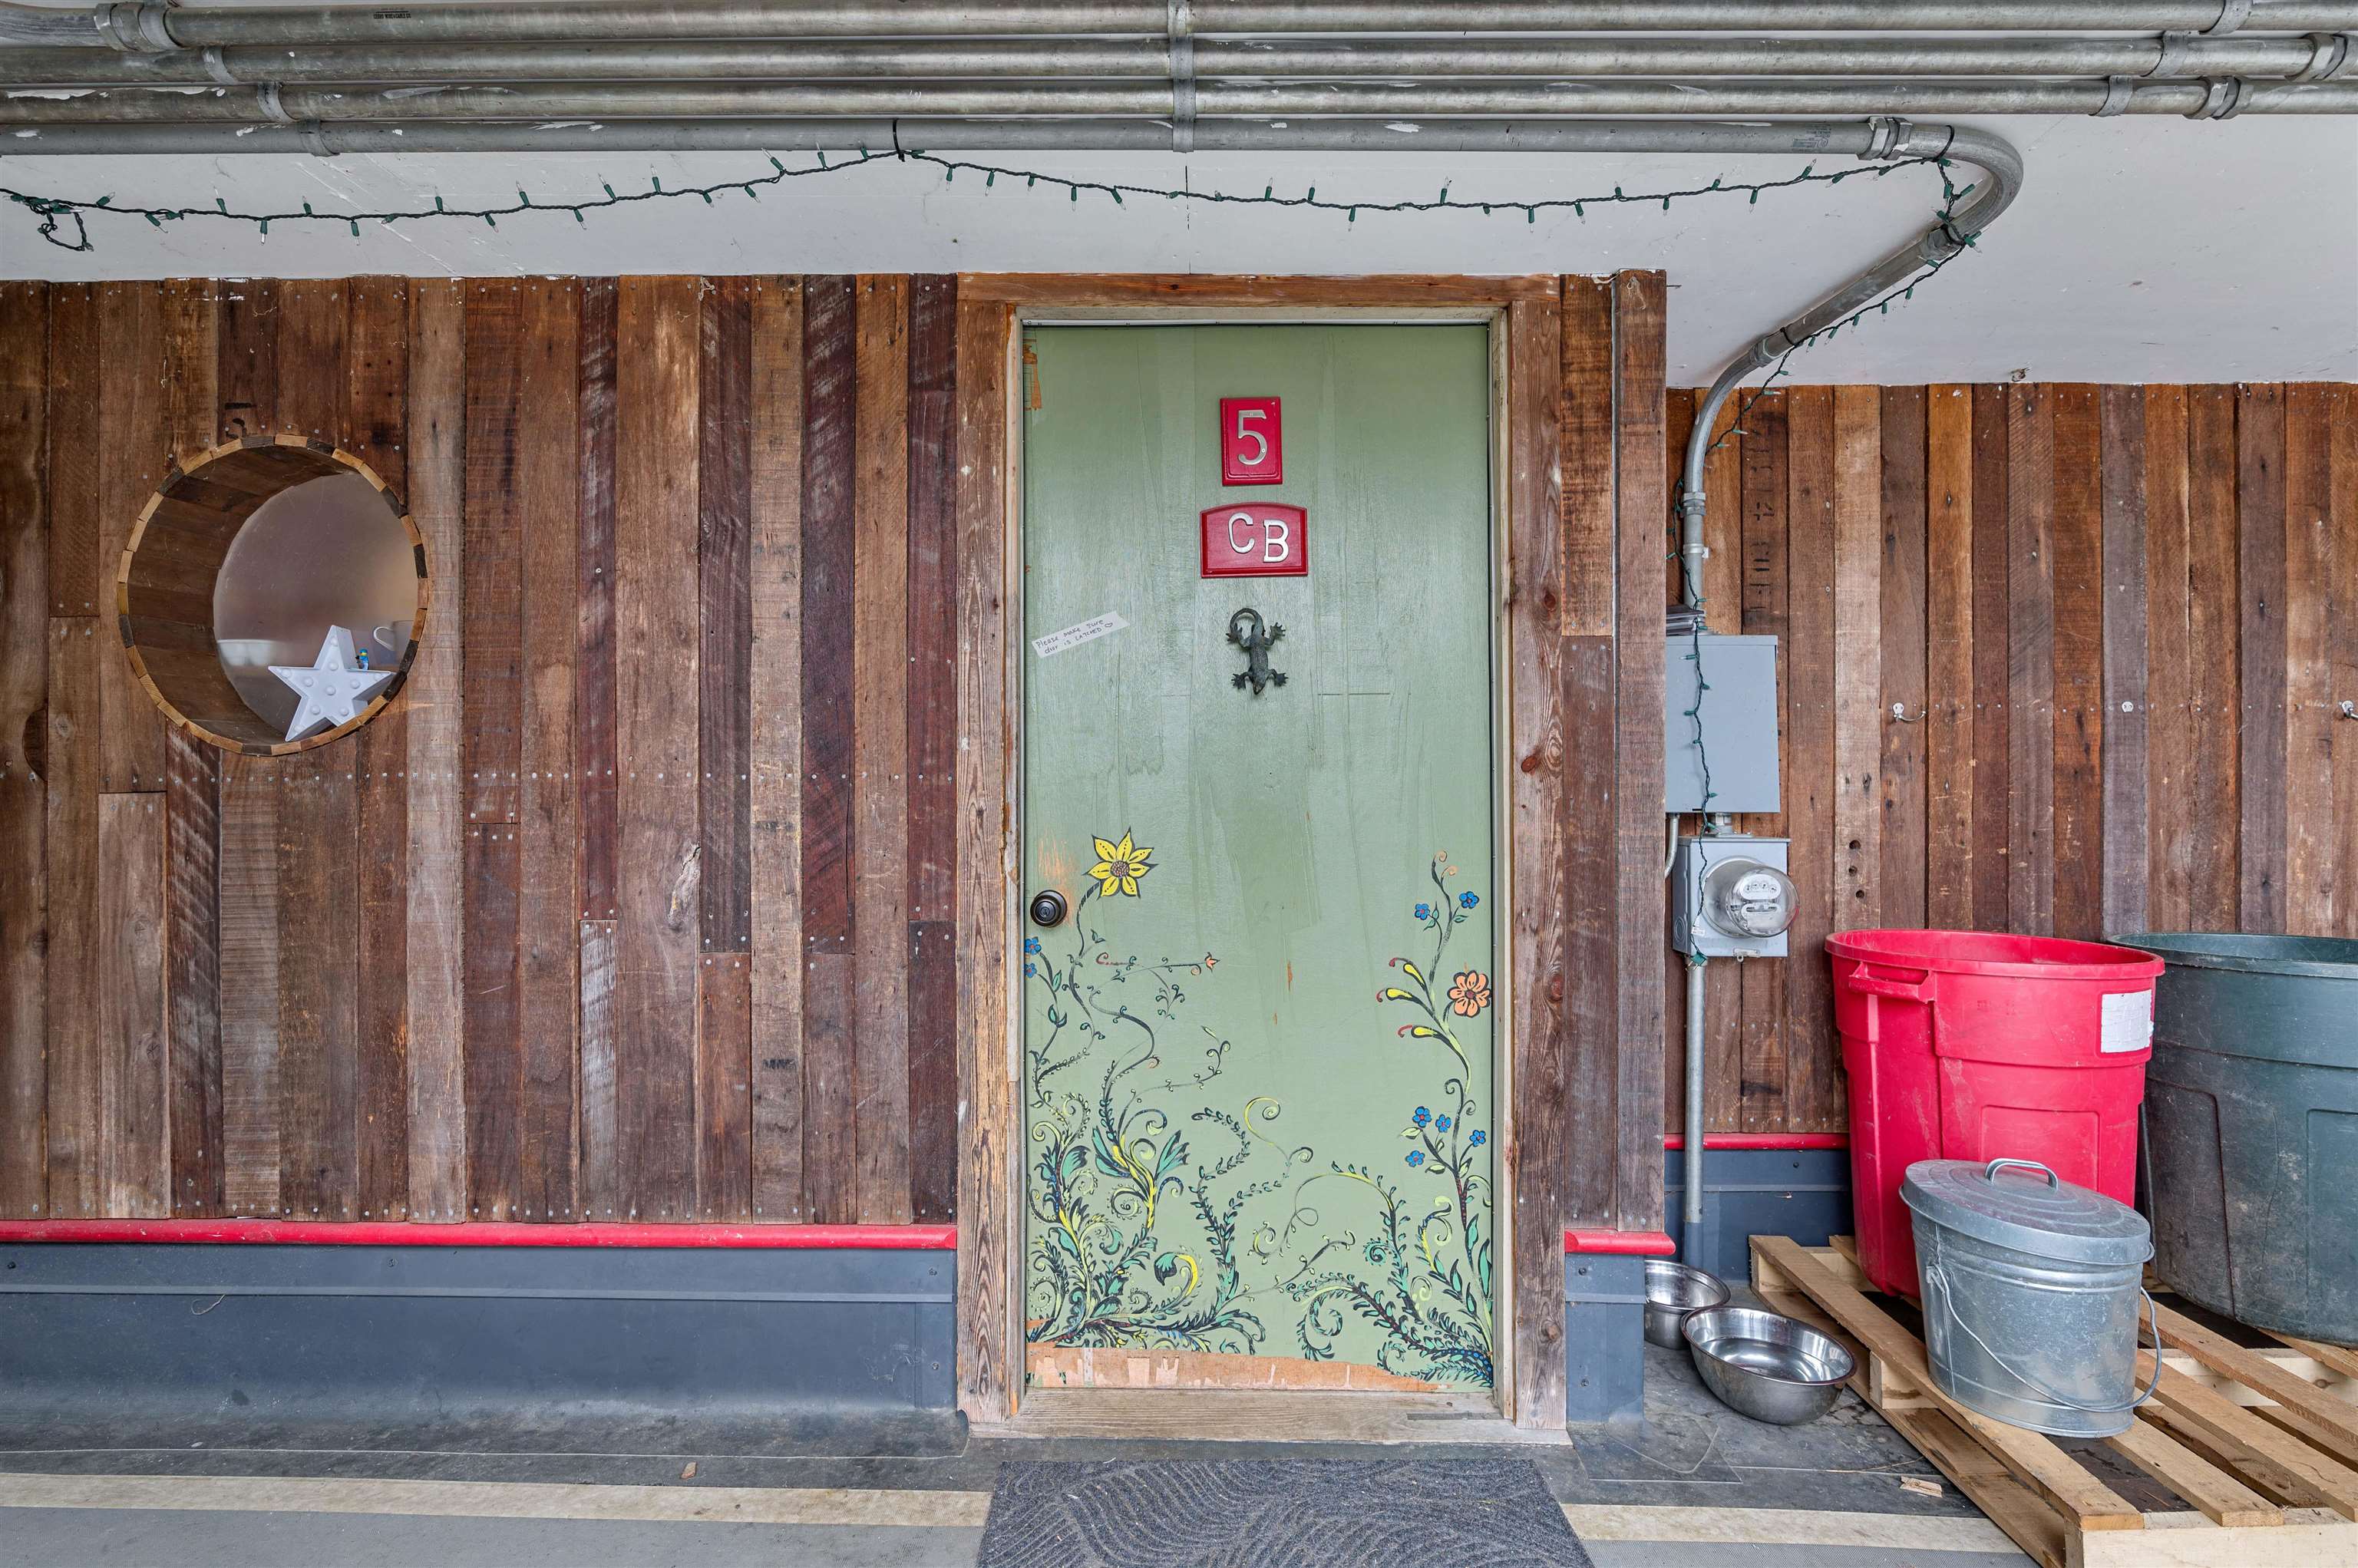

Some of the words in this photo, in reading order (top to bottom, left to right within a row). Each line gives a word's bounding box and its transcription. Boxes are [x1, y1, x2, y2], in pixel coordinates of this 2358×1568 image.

[1238, 409, 1267, 466] 5
[1228, 512, 1290, 563] CB
[1064, 627, 1082, 638] make
[1075, 627, 1102, 641] LATCHED
